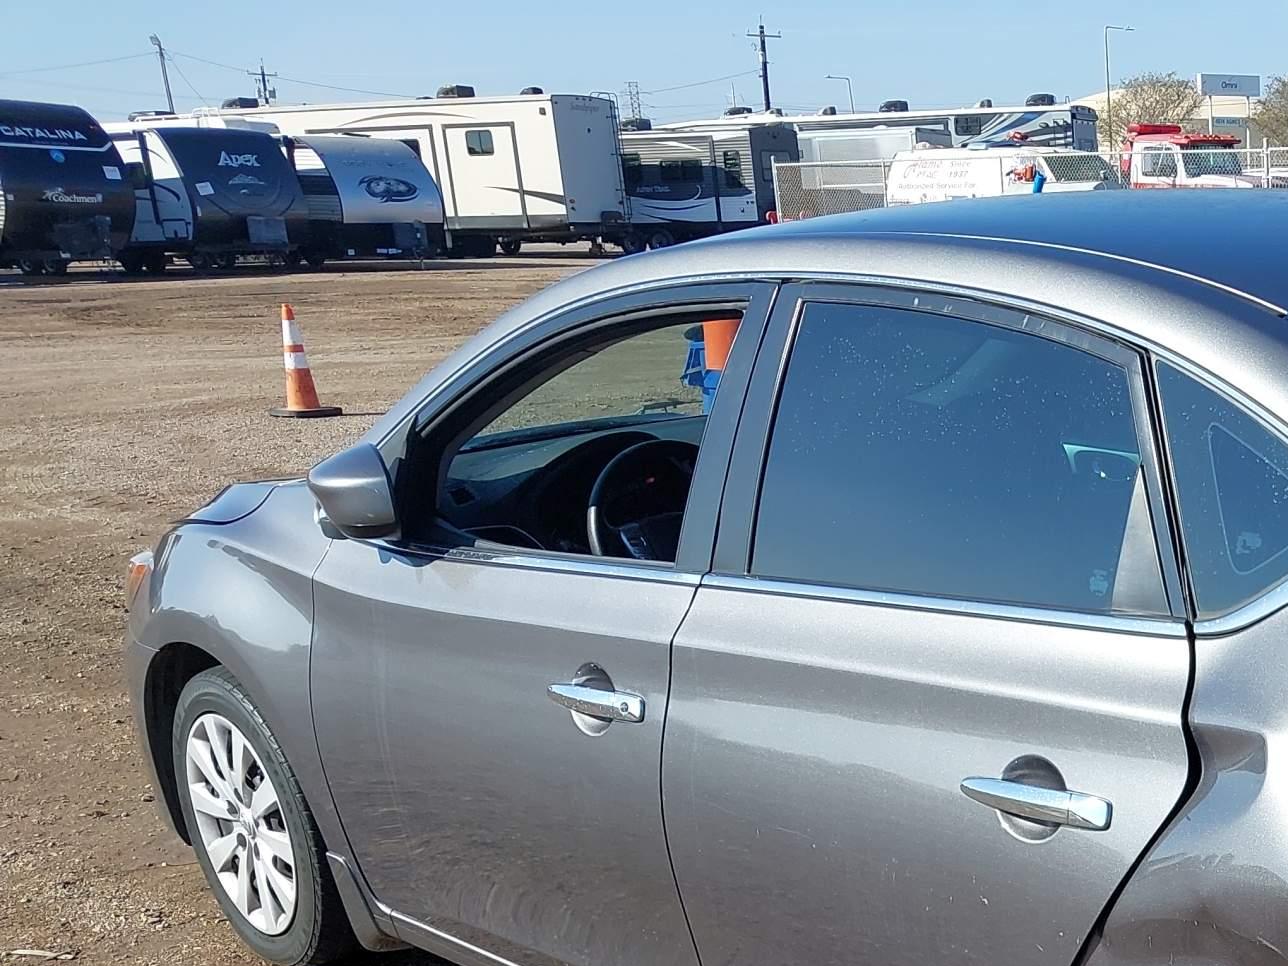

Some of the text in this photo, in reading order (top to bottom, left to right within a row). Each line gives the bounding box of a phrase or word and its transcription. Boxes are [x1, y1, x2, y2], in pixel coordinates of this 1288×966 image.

[1221, 81, 1238, 89] Omni
[0, 126, 88, 141] CATALINA
[217, 150, 261, 167] Apex
[52, 193, 97, 204] Coachmen
